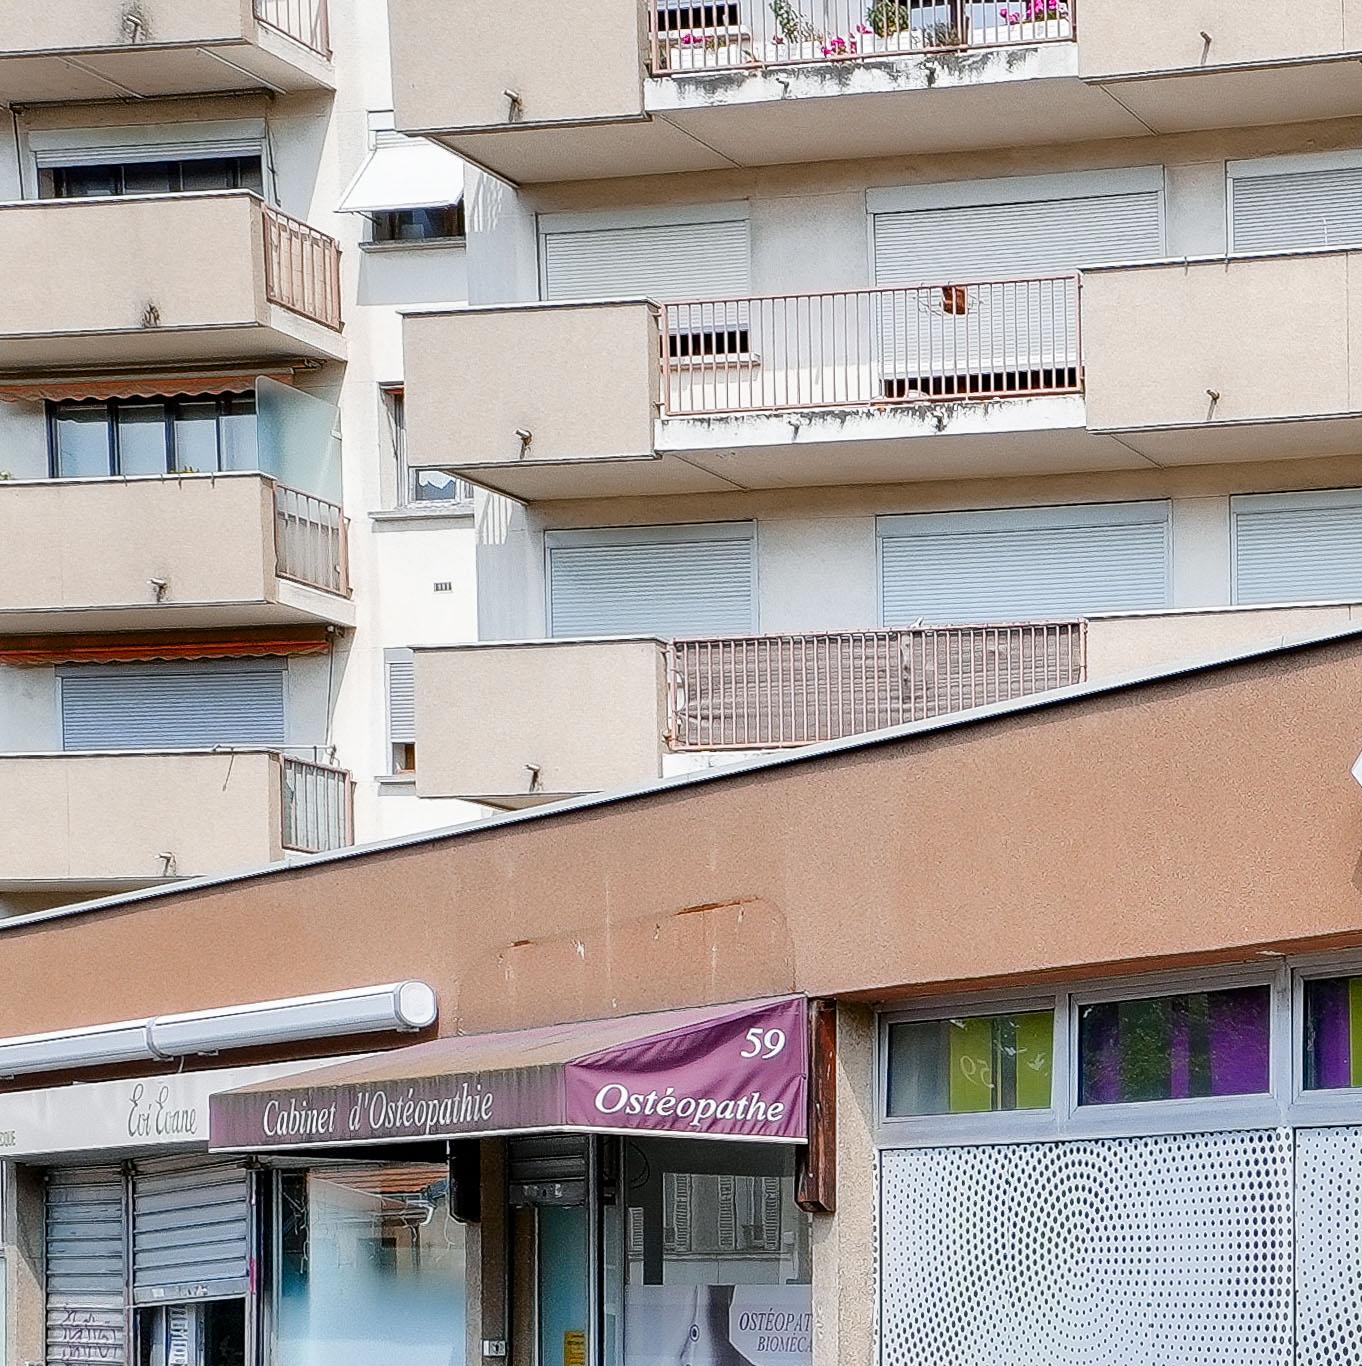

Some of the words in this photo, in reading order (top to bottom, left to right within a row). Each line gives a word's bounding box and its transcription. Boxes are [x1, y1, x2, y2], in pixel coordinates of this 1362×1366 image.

[740, 1027, 786, 1059] 59
[263, 1097, 337, 1137] Cabinet
[349, 1083, 493, 1135] d'Ostéopathie
[594, 1083, 785, 1126] Ostéopathe
